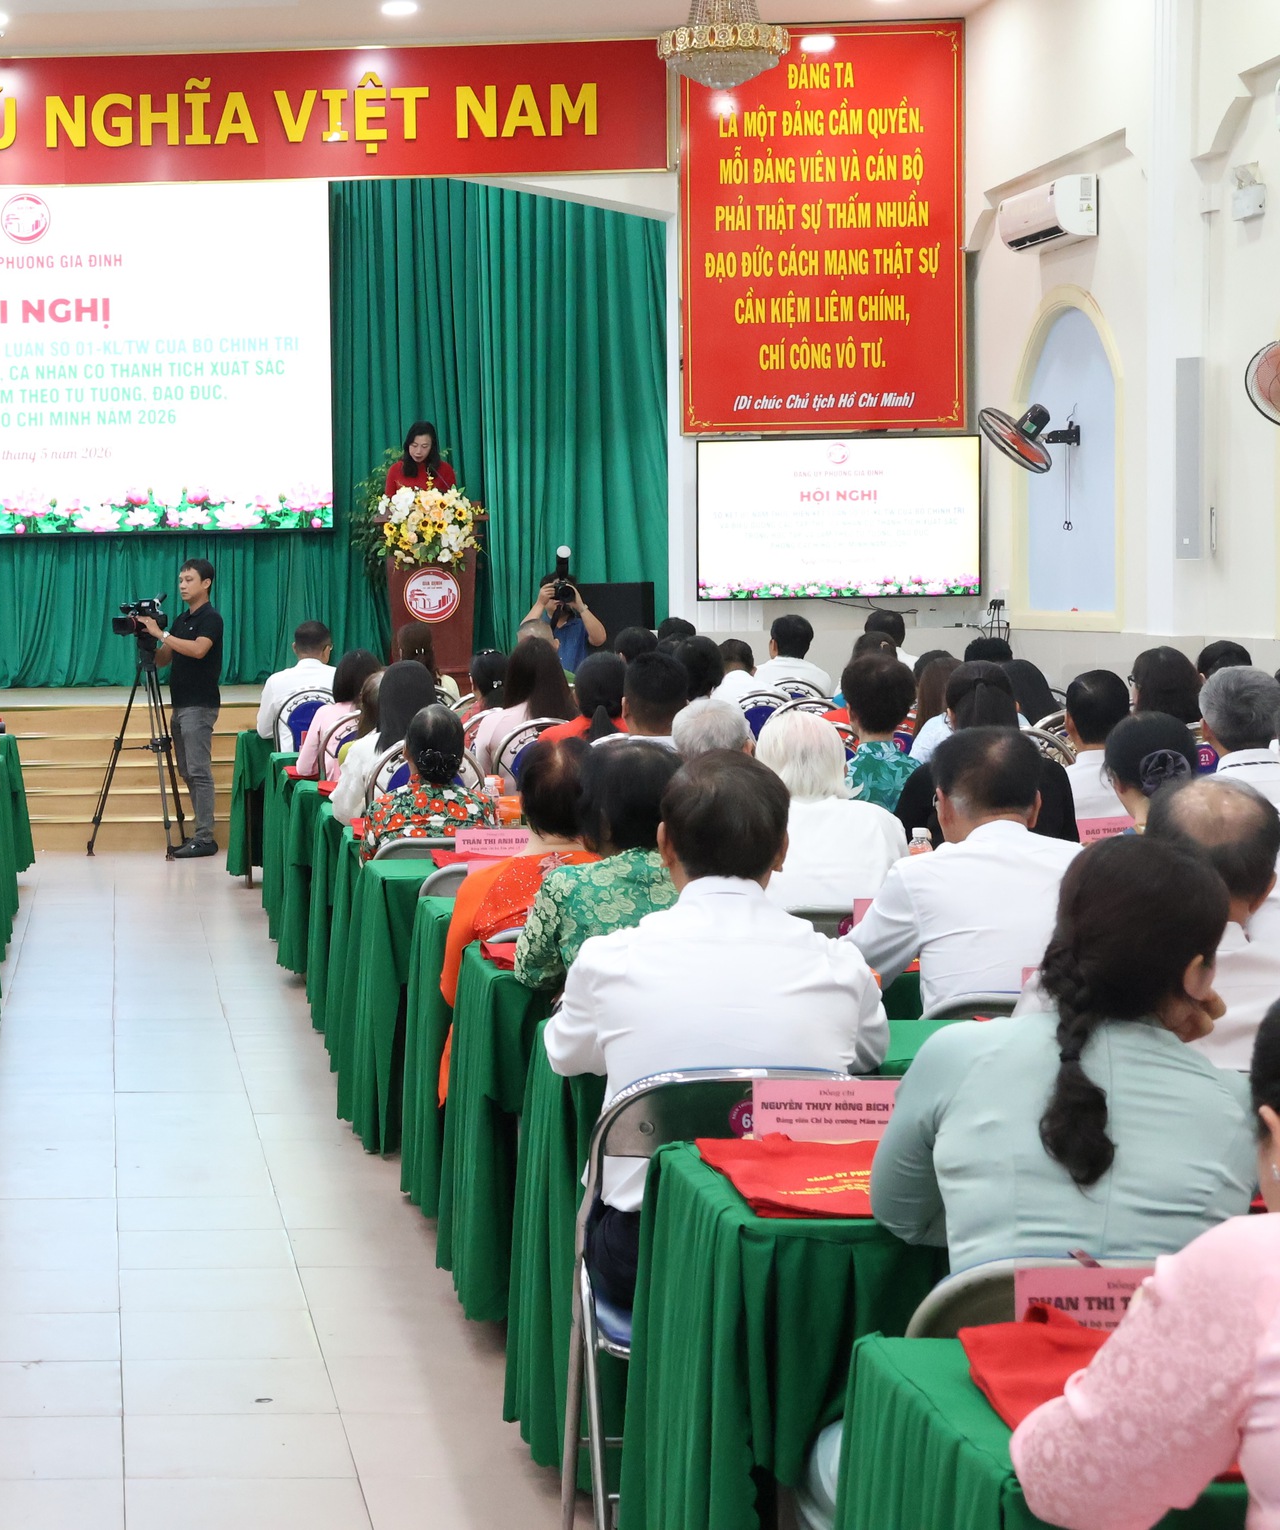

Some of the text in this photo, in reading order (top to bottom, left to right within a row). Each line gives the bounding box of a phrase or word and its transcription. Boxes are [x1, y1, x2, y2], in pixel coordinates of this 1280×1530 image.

[788, 53, 854, 89] ĐẢNG TA
[46, 76, 259, 149] NGHĨA
[273, 71, 430, 155] VIỆT
[455, 83, 598, 138] NAM
[744, 104, 777, 140] MỘT
[782, 100, 824, 136] ĐẢNG
[829, 98, 862, 136] CẦM
[867, 96, 924, 139] QUYỀN.
[720, 146, 923, 185] MỖI ĐẢNG VIÊN VÀ CÁN BỘ
[716, 190, 928, 235] PHẢI THẬT SỰ THẤM NHUẦN
[60, 255, 83, 268] GIA
[705, 241, 940, 283] ĐẠO ĐỨC CÁCH MẠNG THẬT SỰ
[22, 298, 110, 329] NGHỊ
[735, 287, 909, 328] CẦN KIỆM LIÊM CHÍNH,
[759, 336, 885, 370] CHÍ CÔNG VÔ TƯ.
[19, 388, 60, 404] THEO
[734, 392, 914, 411] (Di chúc Chủ tịch Hồ Chí Minh)
[49, 410, 91, 426] MINH
[138, 409, 176, 425] 2026
[800, 487, 878, 505] HỘI NGHỊ
[1200, 754, 1209, 762] 21
